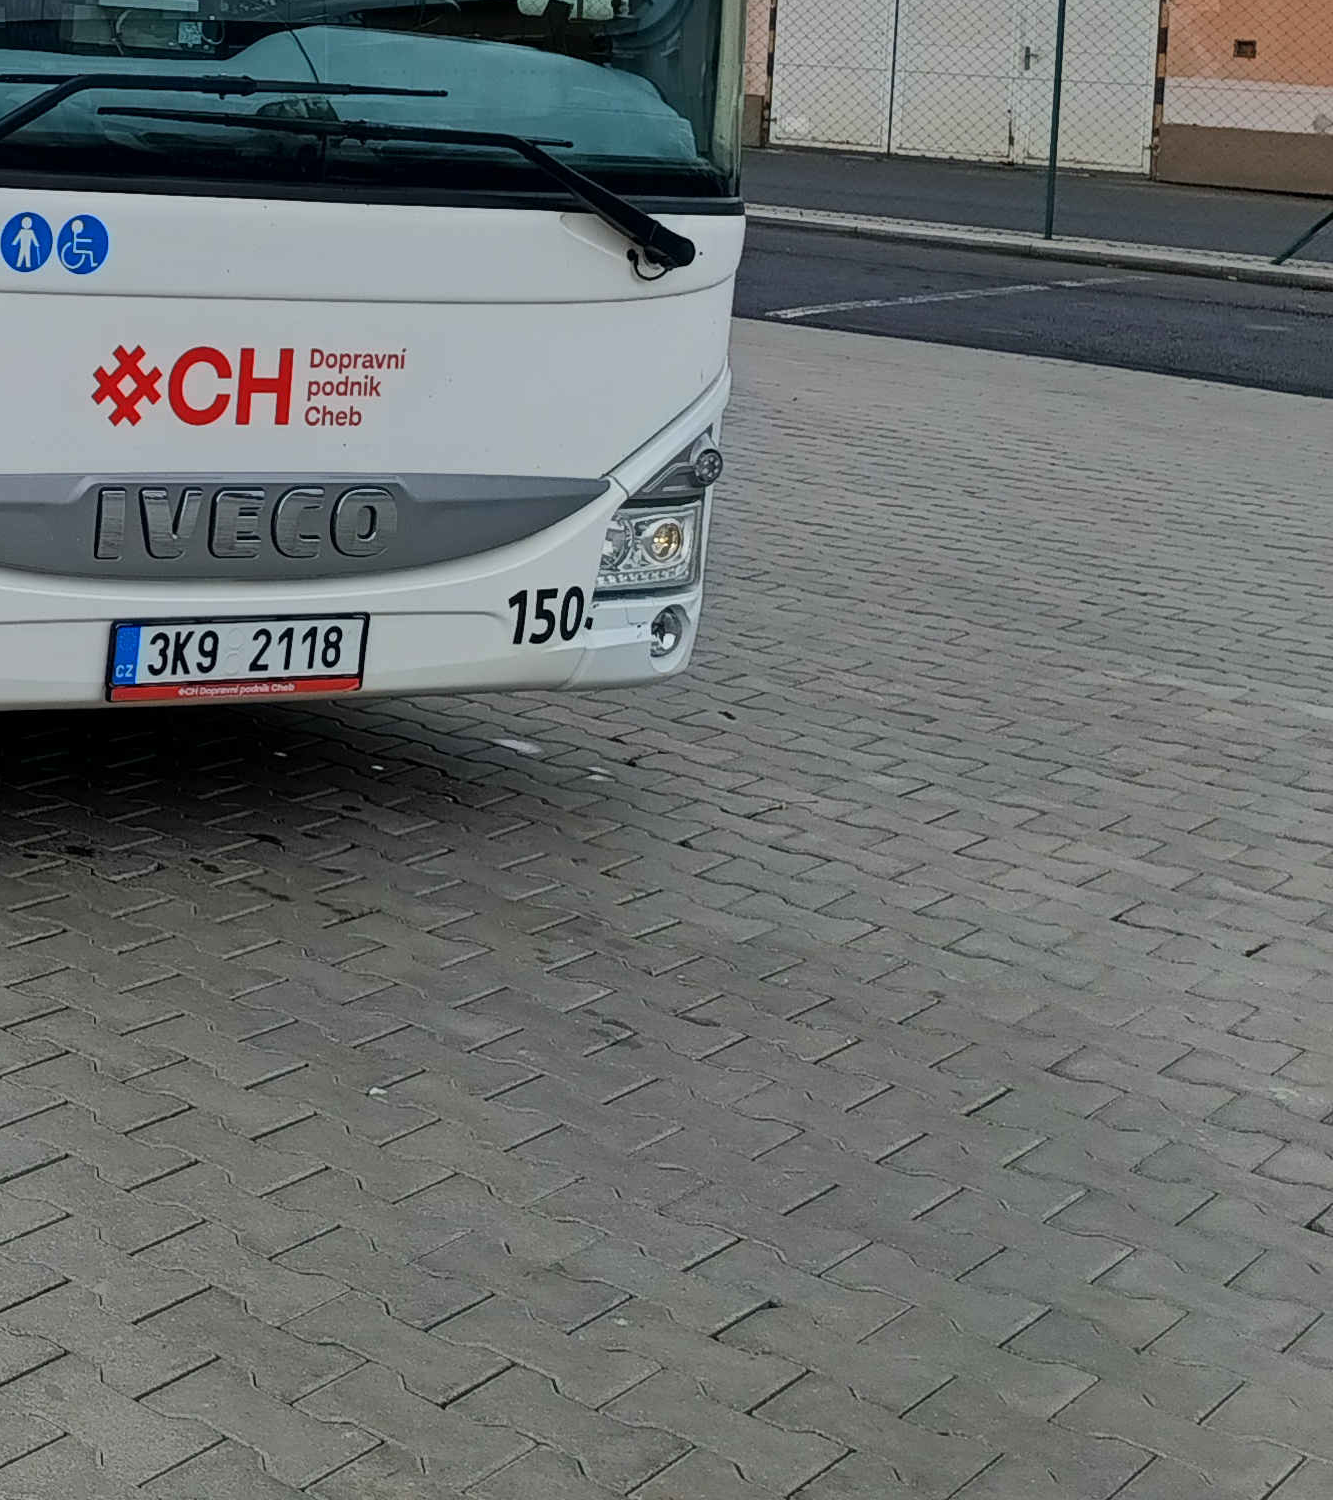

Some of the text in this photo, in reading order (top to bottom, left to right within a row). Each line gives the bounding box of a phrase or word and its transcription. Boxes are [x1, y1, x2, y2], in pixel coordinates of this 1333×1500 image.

[309, 348, 407, 374] Dopravní
[167, 346, 295, 426] CH
[306, 374, 382, 402] podnik
[304, 405, 363, 427] Cheb
[93, 486, 399, 561] IVECO
[146, 625, 344, 676] 3K9 2118
[115, 664, 134, 678] CZ
[199, 685, 238, 697] Dopravní
[239, 683, 270, 696] podnik
[271, 683, 296, 693] Cheb
